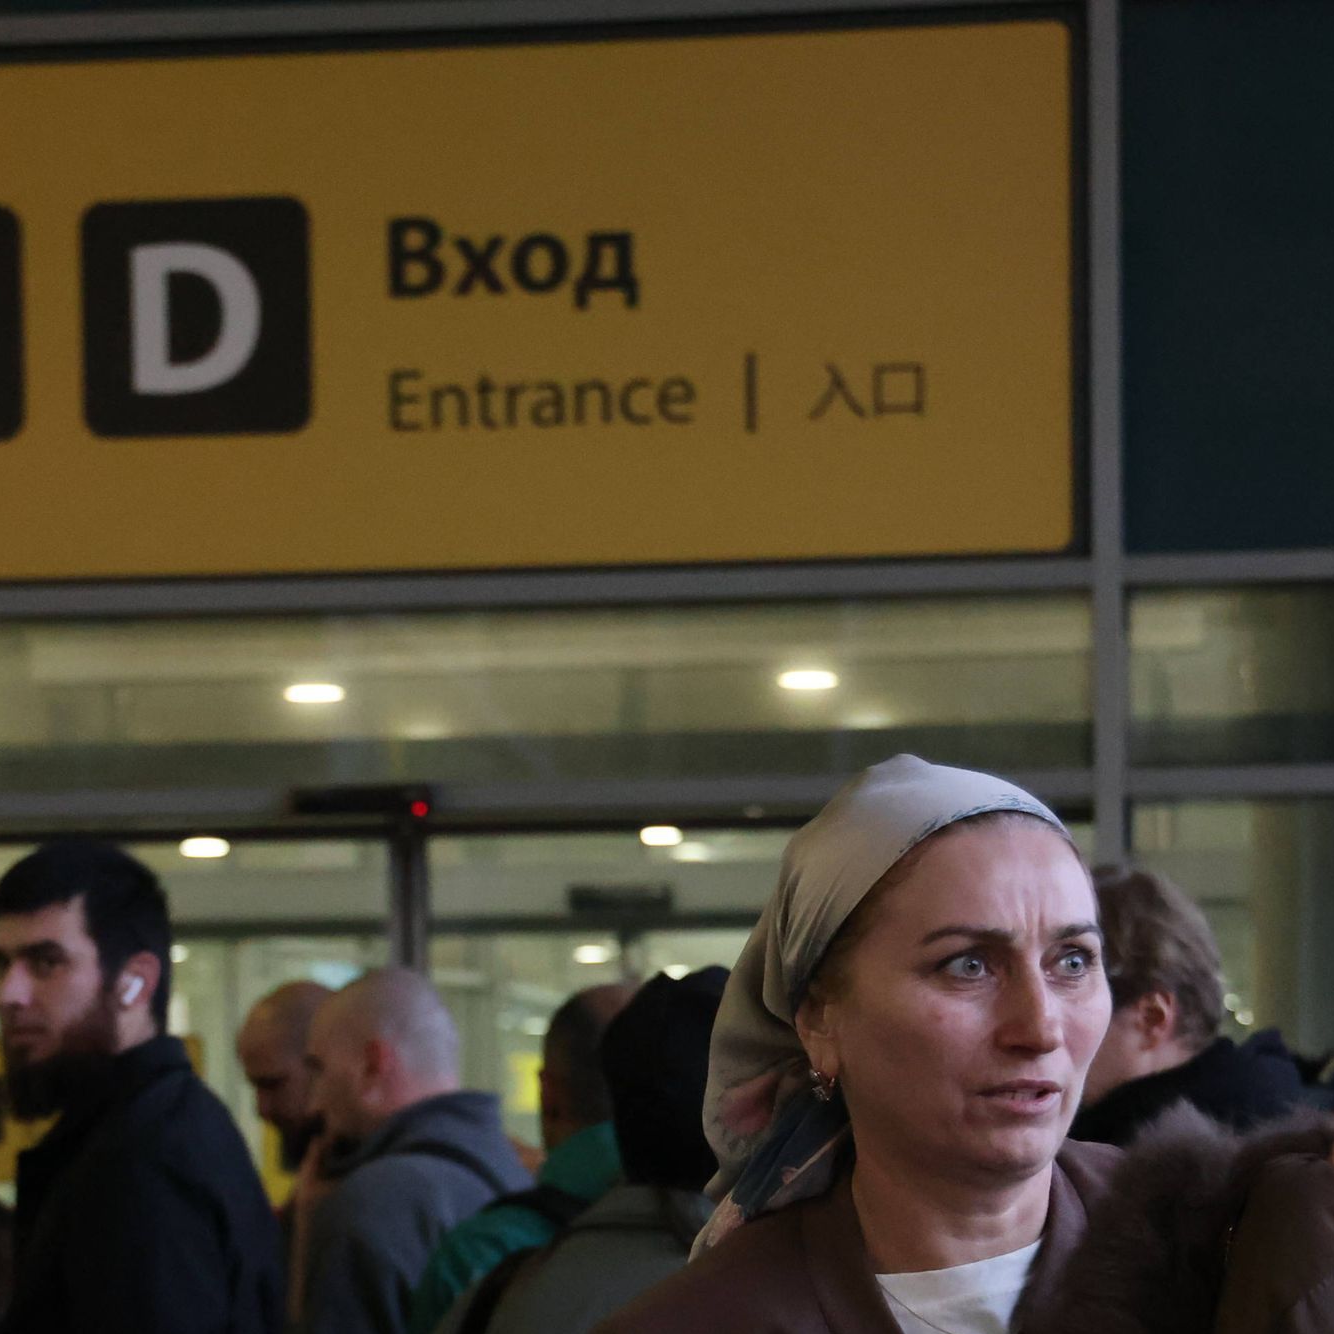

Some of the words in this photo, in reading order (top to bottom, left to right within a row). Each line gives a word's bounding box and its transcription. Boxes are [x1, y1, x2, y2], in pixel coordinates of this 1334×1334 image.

[389, 217, 639, 309] Вход
[130, 241, 262, 395] D
[389, 369, 696, 432] Entrance
[809, 363, 924, 420] 入口
